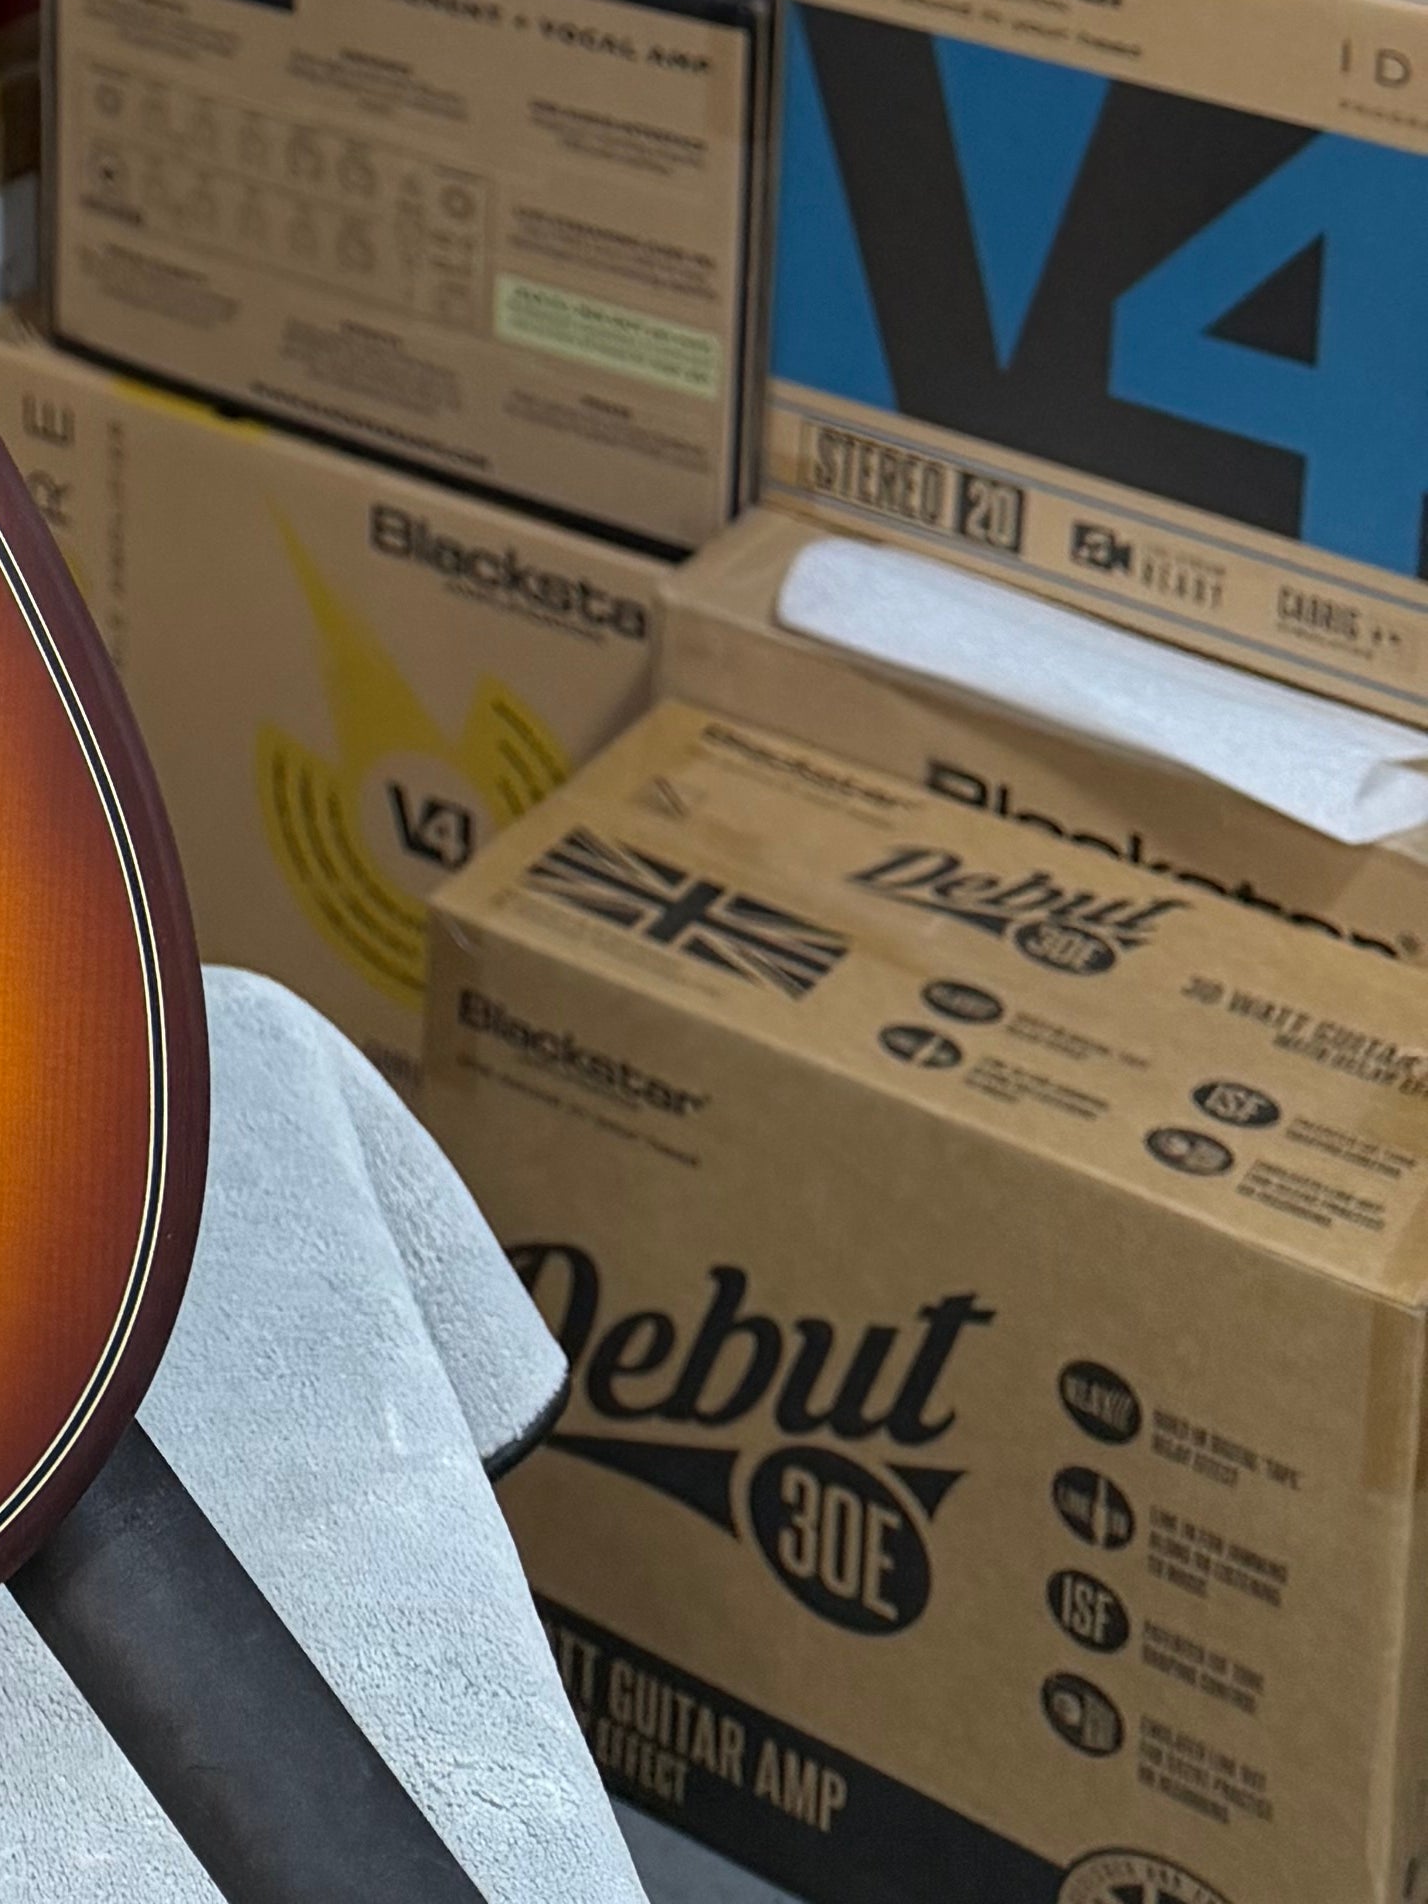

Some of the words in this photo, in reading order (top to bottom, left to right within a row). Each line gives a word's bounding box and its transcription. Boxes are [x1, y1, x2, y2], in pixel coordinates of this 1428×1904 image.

[537, 17, 637, 63] VOCAL
[646, 46, 711, 73] AMP
[813, 431, 943, 528] STEREO
[965, 477, 1022, 554] 20
[849, 847, 1194, 929] Debut
[457, 989, 701, 1118] Blackstar
[501, 1241, 998, 1446] Debut
[777, 1463, 907, 1624] 30E
[1061, 1574, 1114, 1643] ISF
[607, 1656, 746, 1788] GUITAR
[753, 1738, 849, 1835] AMP
